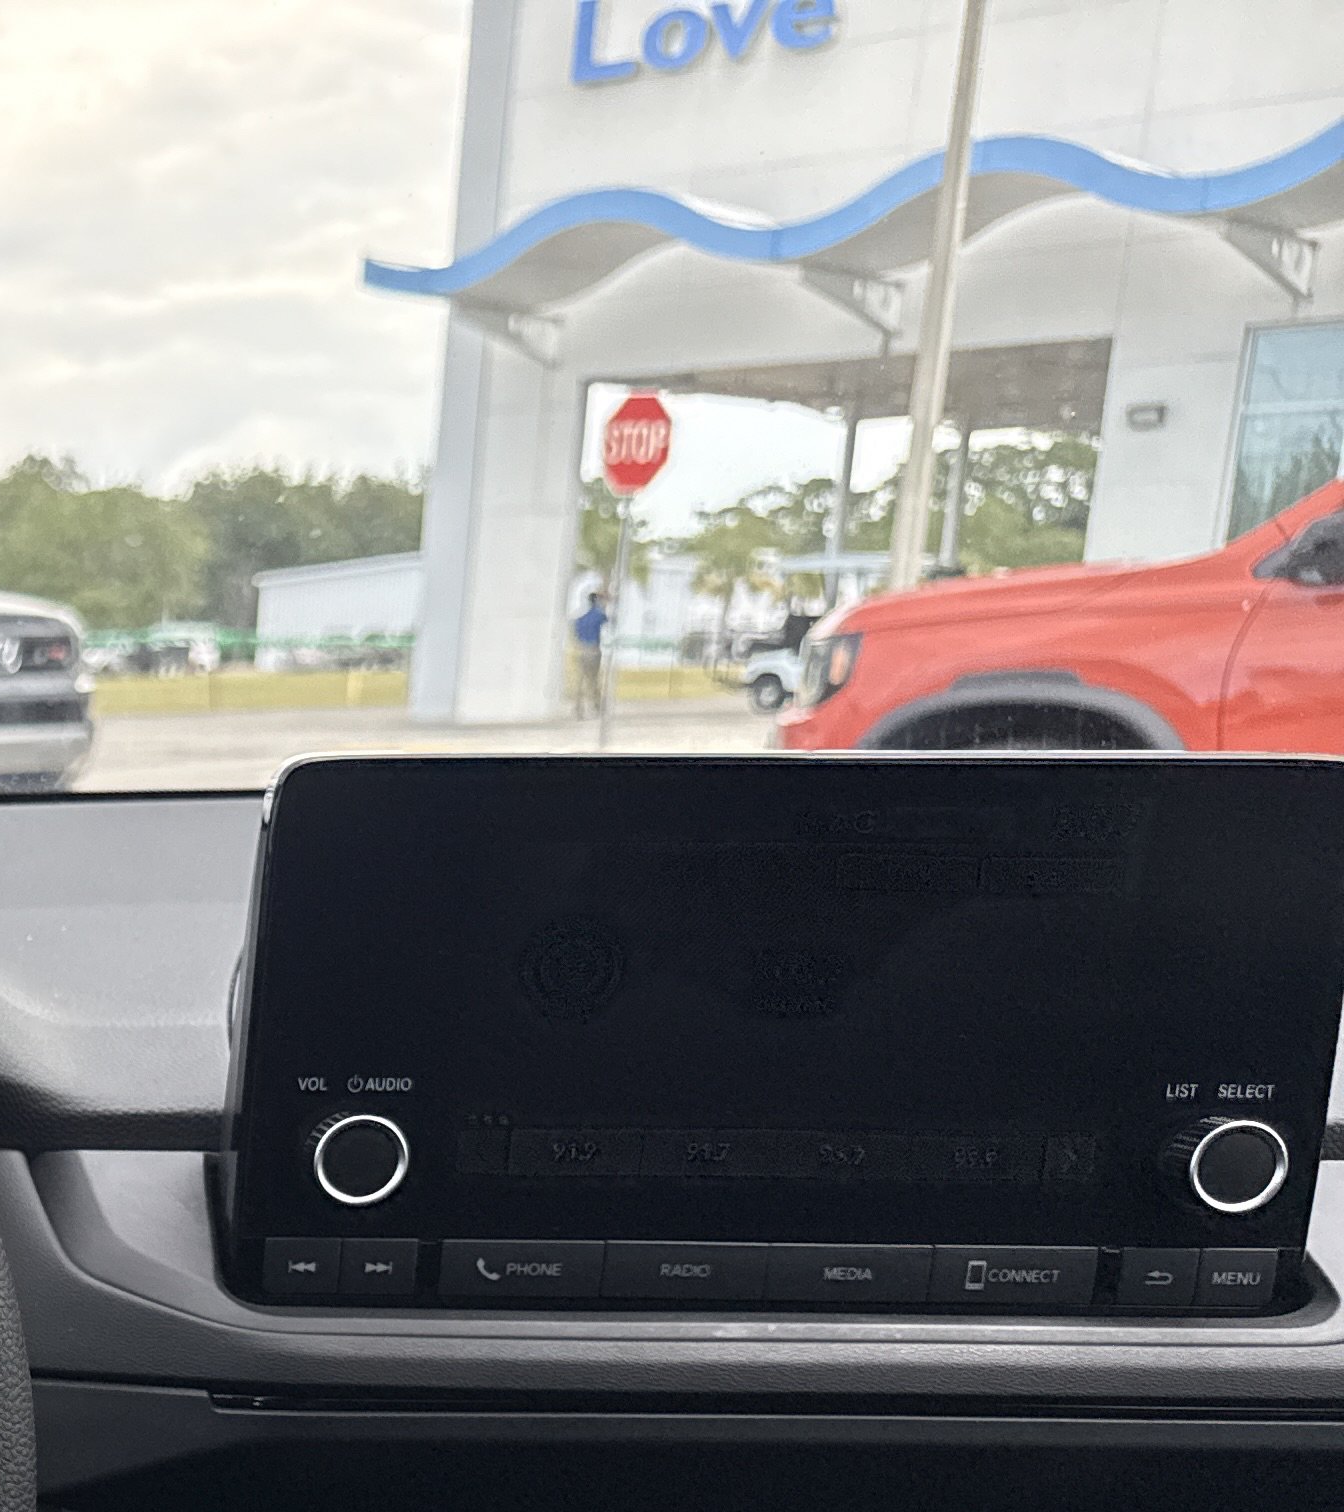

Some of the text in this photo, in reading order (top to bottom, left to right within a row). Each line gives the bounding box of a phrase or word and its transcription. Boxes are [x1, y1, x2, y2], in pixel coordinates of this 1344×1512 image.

[572, 0, 838, 84] Love
[605, 419, 670, 465] STOP
[298, 1077, 412, 1092] VOL AUDIO
[1166, 1083, 1276, 1099] LIST SELECT
[506, 1262, 563, 1278] PHONE
[659, 1263, 711, 1278] RADIO
[823, 1266, 873, 1281] MEDIA
[988, 1268, 1060, 1284] CONNECT
[1212, 1271, 1261, 1286] MENU
